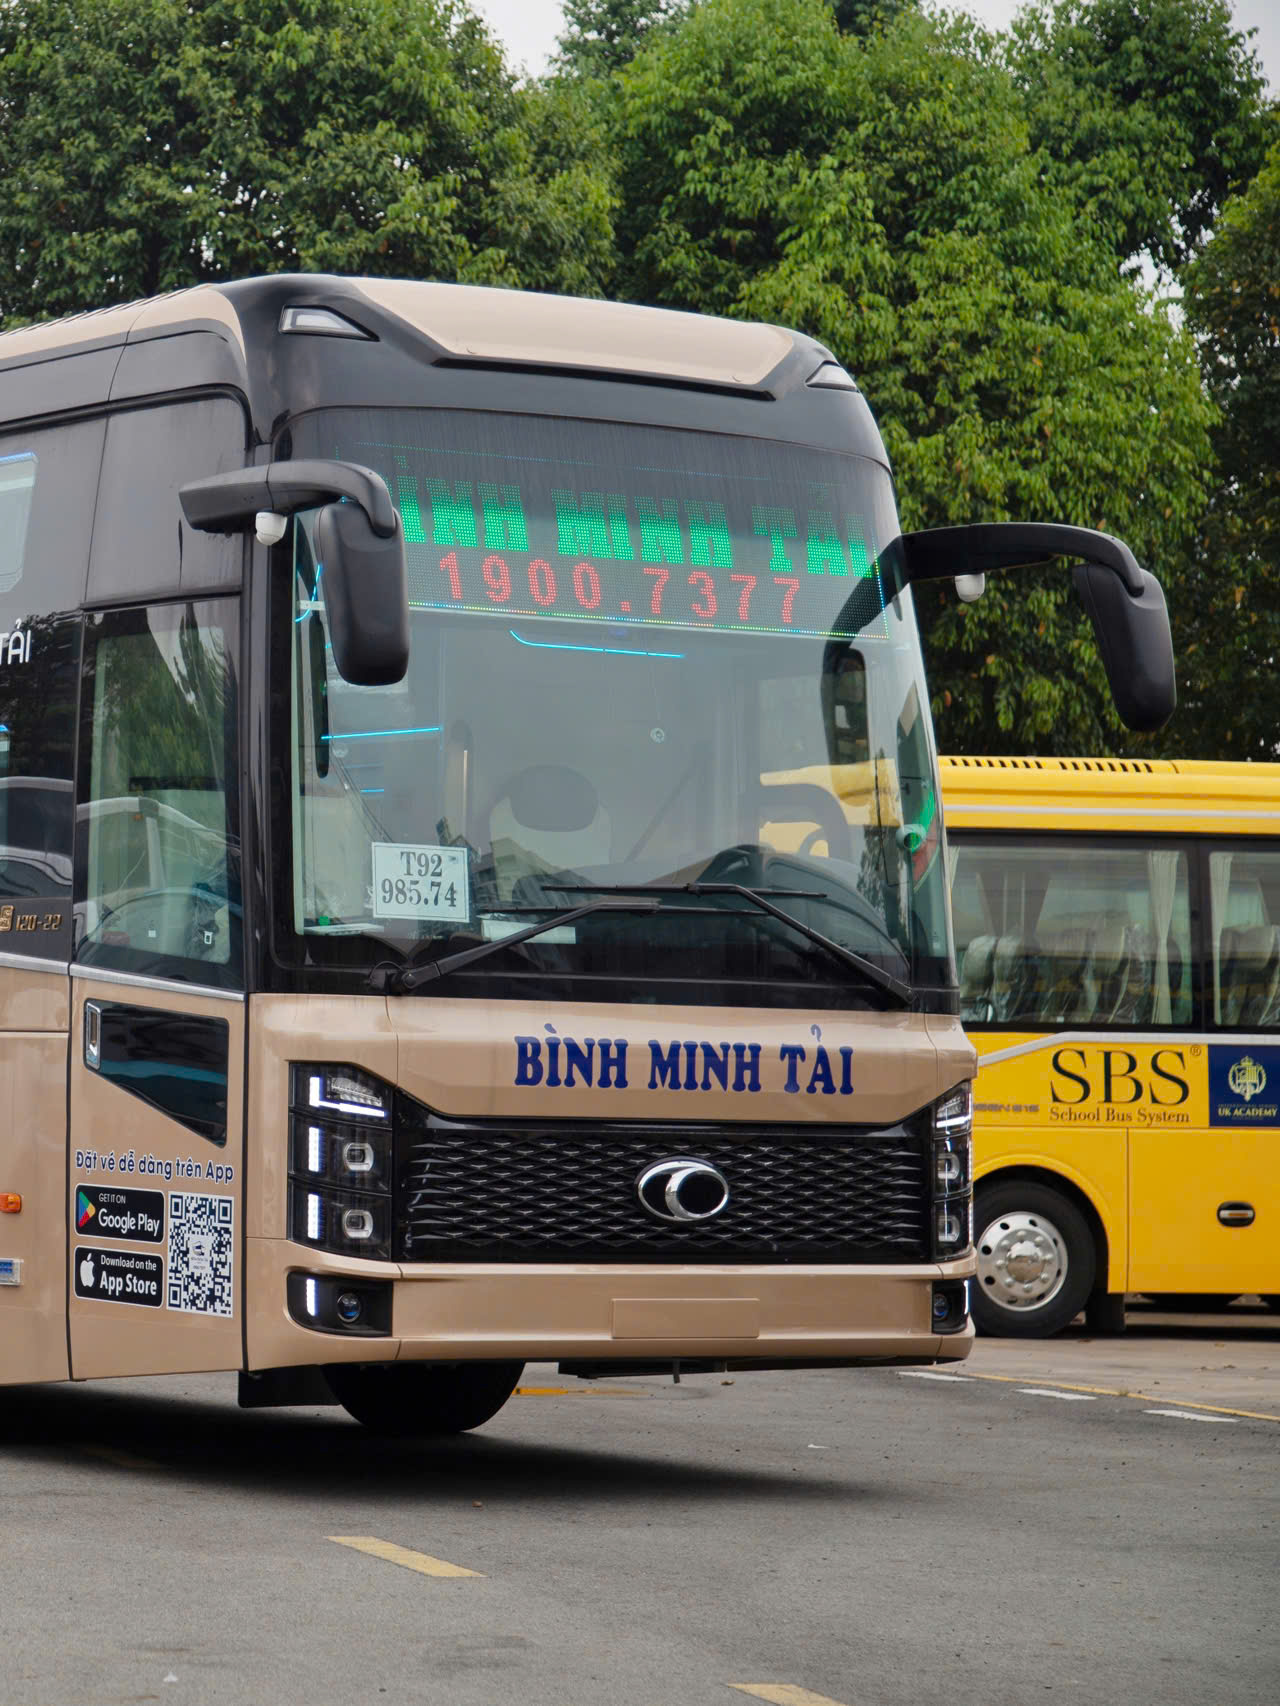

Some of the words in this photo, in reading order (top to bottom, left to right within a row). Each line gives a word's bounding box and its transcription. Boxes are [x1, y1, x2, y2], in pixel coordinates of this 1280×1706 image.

[384, 455, 529, 552] ÌNH
[551, 488, 733, 569] MINH
[439, 551, 800, 623] 1900.7377
[400, 851, 442, 877] T92
[381, 879, 457, 907] 985.74
[514, 1022, 629, 1089] BÌNH
[648, 1039, 762, 1092] MINH
[779, 1024, 855, 1095] TẢI
[1050, 1048, 1190, 1106] SBS
[1049, 1107, 1100, 1122] School
[1105, 1108, 1132, 1122] Bus
[1137, 1108, 1191, 1127] System
[1218, 1108, 1231, 1117] UK
[1233, 1108, 1278, 1117] ACADEMY
[76, 1150, 97, 1175] Đặt
[101, 1152, 115, 1171] vé
[119, 1149, 135, 1173] dễ
[138, 1152, 172, 1181] dàng
[175, 1156, 202, 1178] trên
[205, 1160, 234, 1184] App
[99, 1193, 111, 1203] GET
[116, 1195, 126, 1204] ON
[98, 1208, 136, 1234] Google
[138, 1212, 160, 1237] Play
[100, 1255, 134, 1269] Download
[135, 1261, 145, 1270] on
[145, 1259, 157, 1271] the
[100, 1271, 123, 1296] App
[126, 1274, 157, 1295] Store
